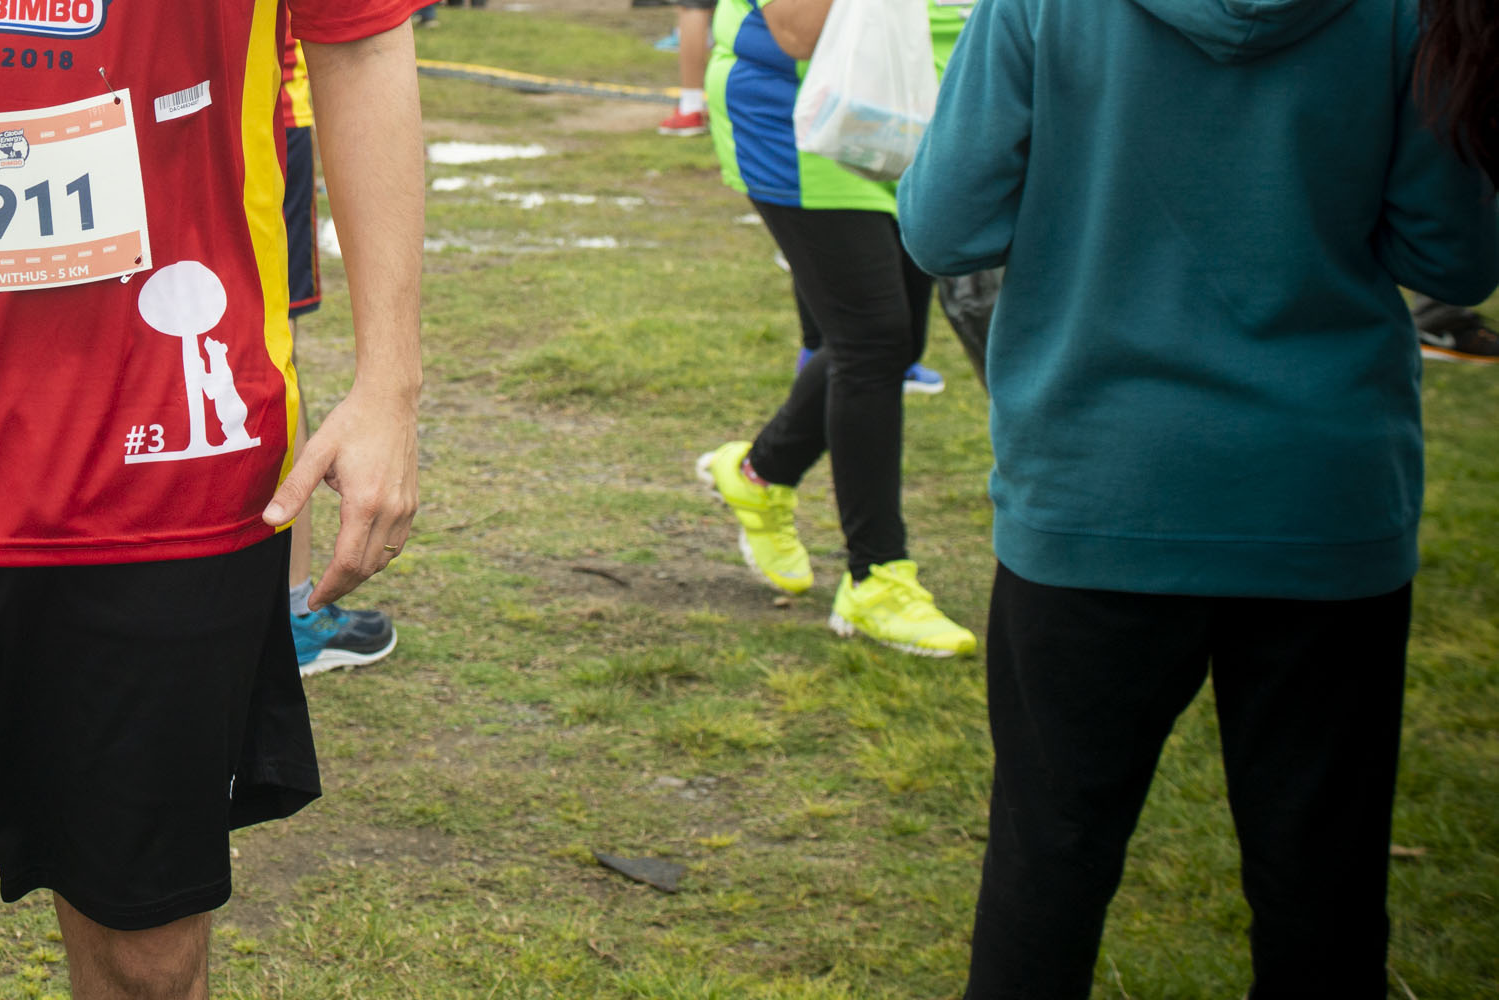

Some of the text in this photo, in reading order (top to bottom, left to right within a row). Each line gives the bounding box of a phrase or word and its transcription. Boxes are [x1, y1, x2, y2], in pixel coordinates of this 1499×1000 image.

[0, 47, 74, 70] 2018
[58, 269, 67, 280] 5
[68, 265, 90, 278] KM
[124, 424, 165, 454] #3
